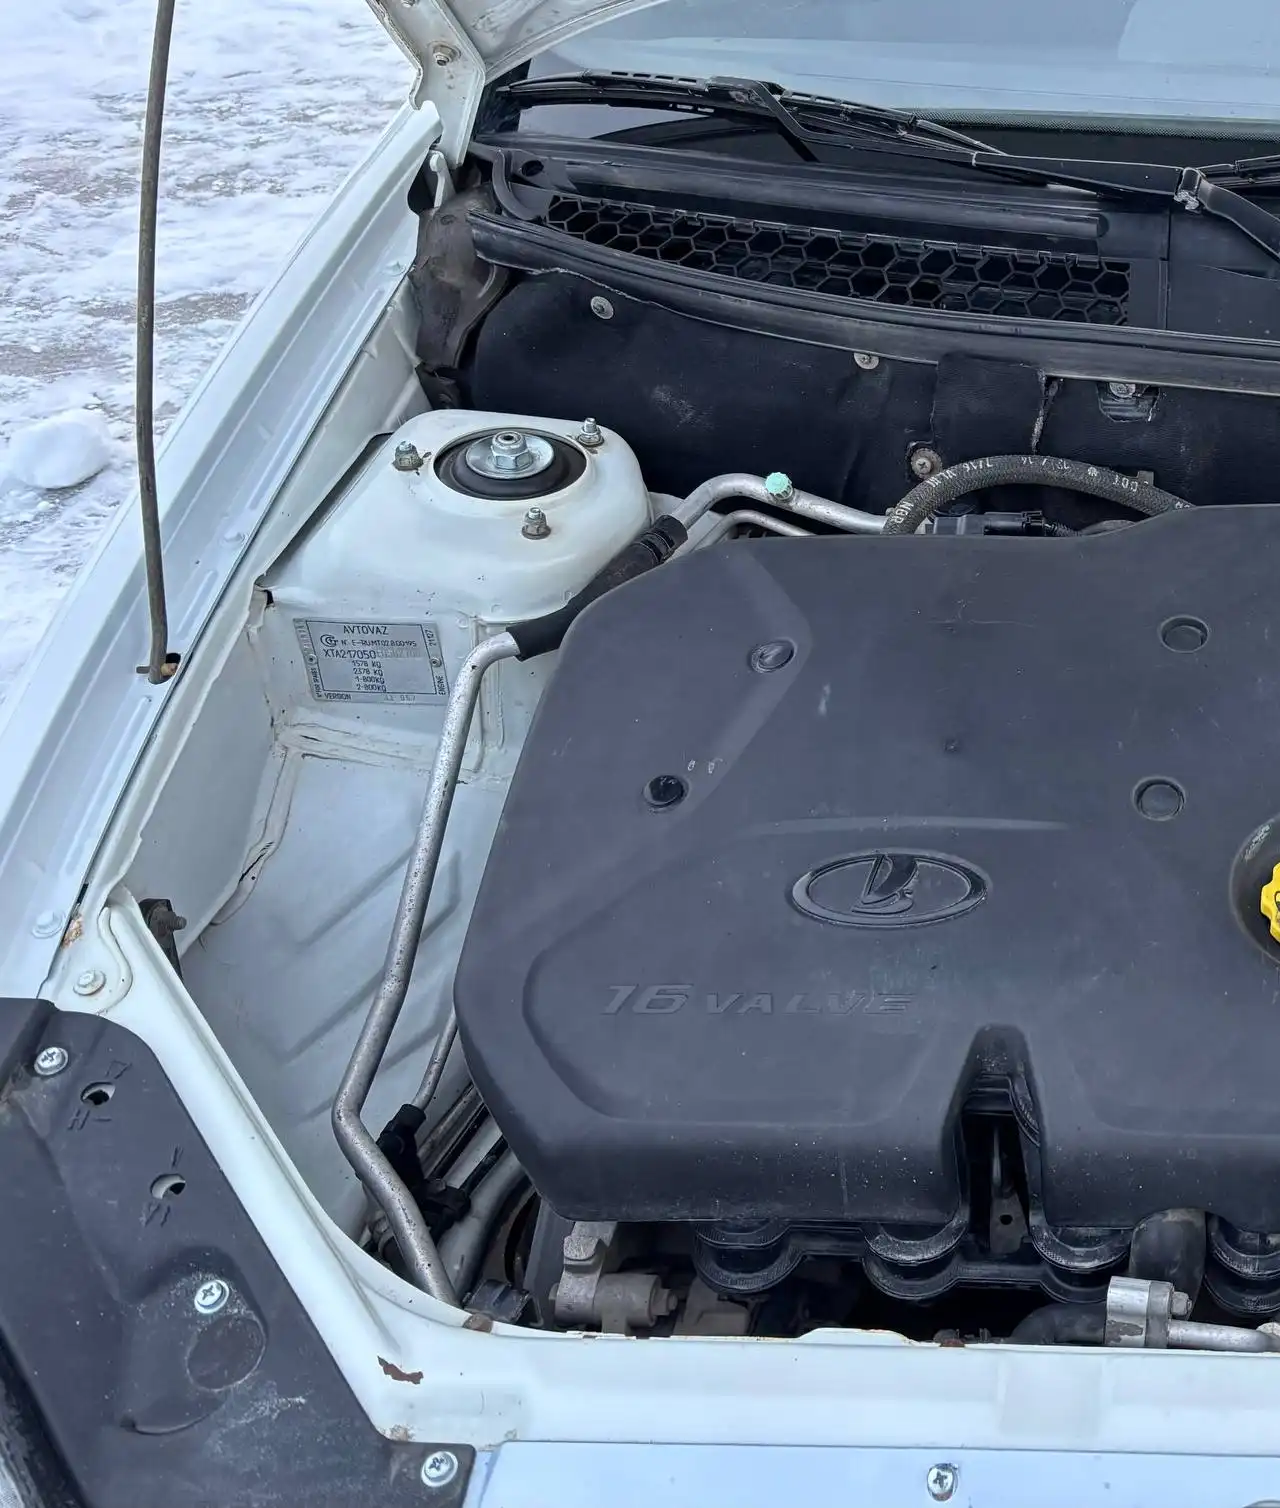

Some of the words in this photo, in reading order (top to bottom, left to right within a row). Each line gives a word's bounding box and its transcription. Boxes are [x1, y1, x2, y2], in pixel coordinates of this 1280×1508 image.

[343, 625, 389, 635] AVTOVAZ
[600, 983, 695, 1016] 16
[706, 989, 917, 1016] VALVE
